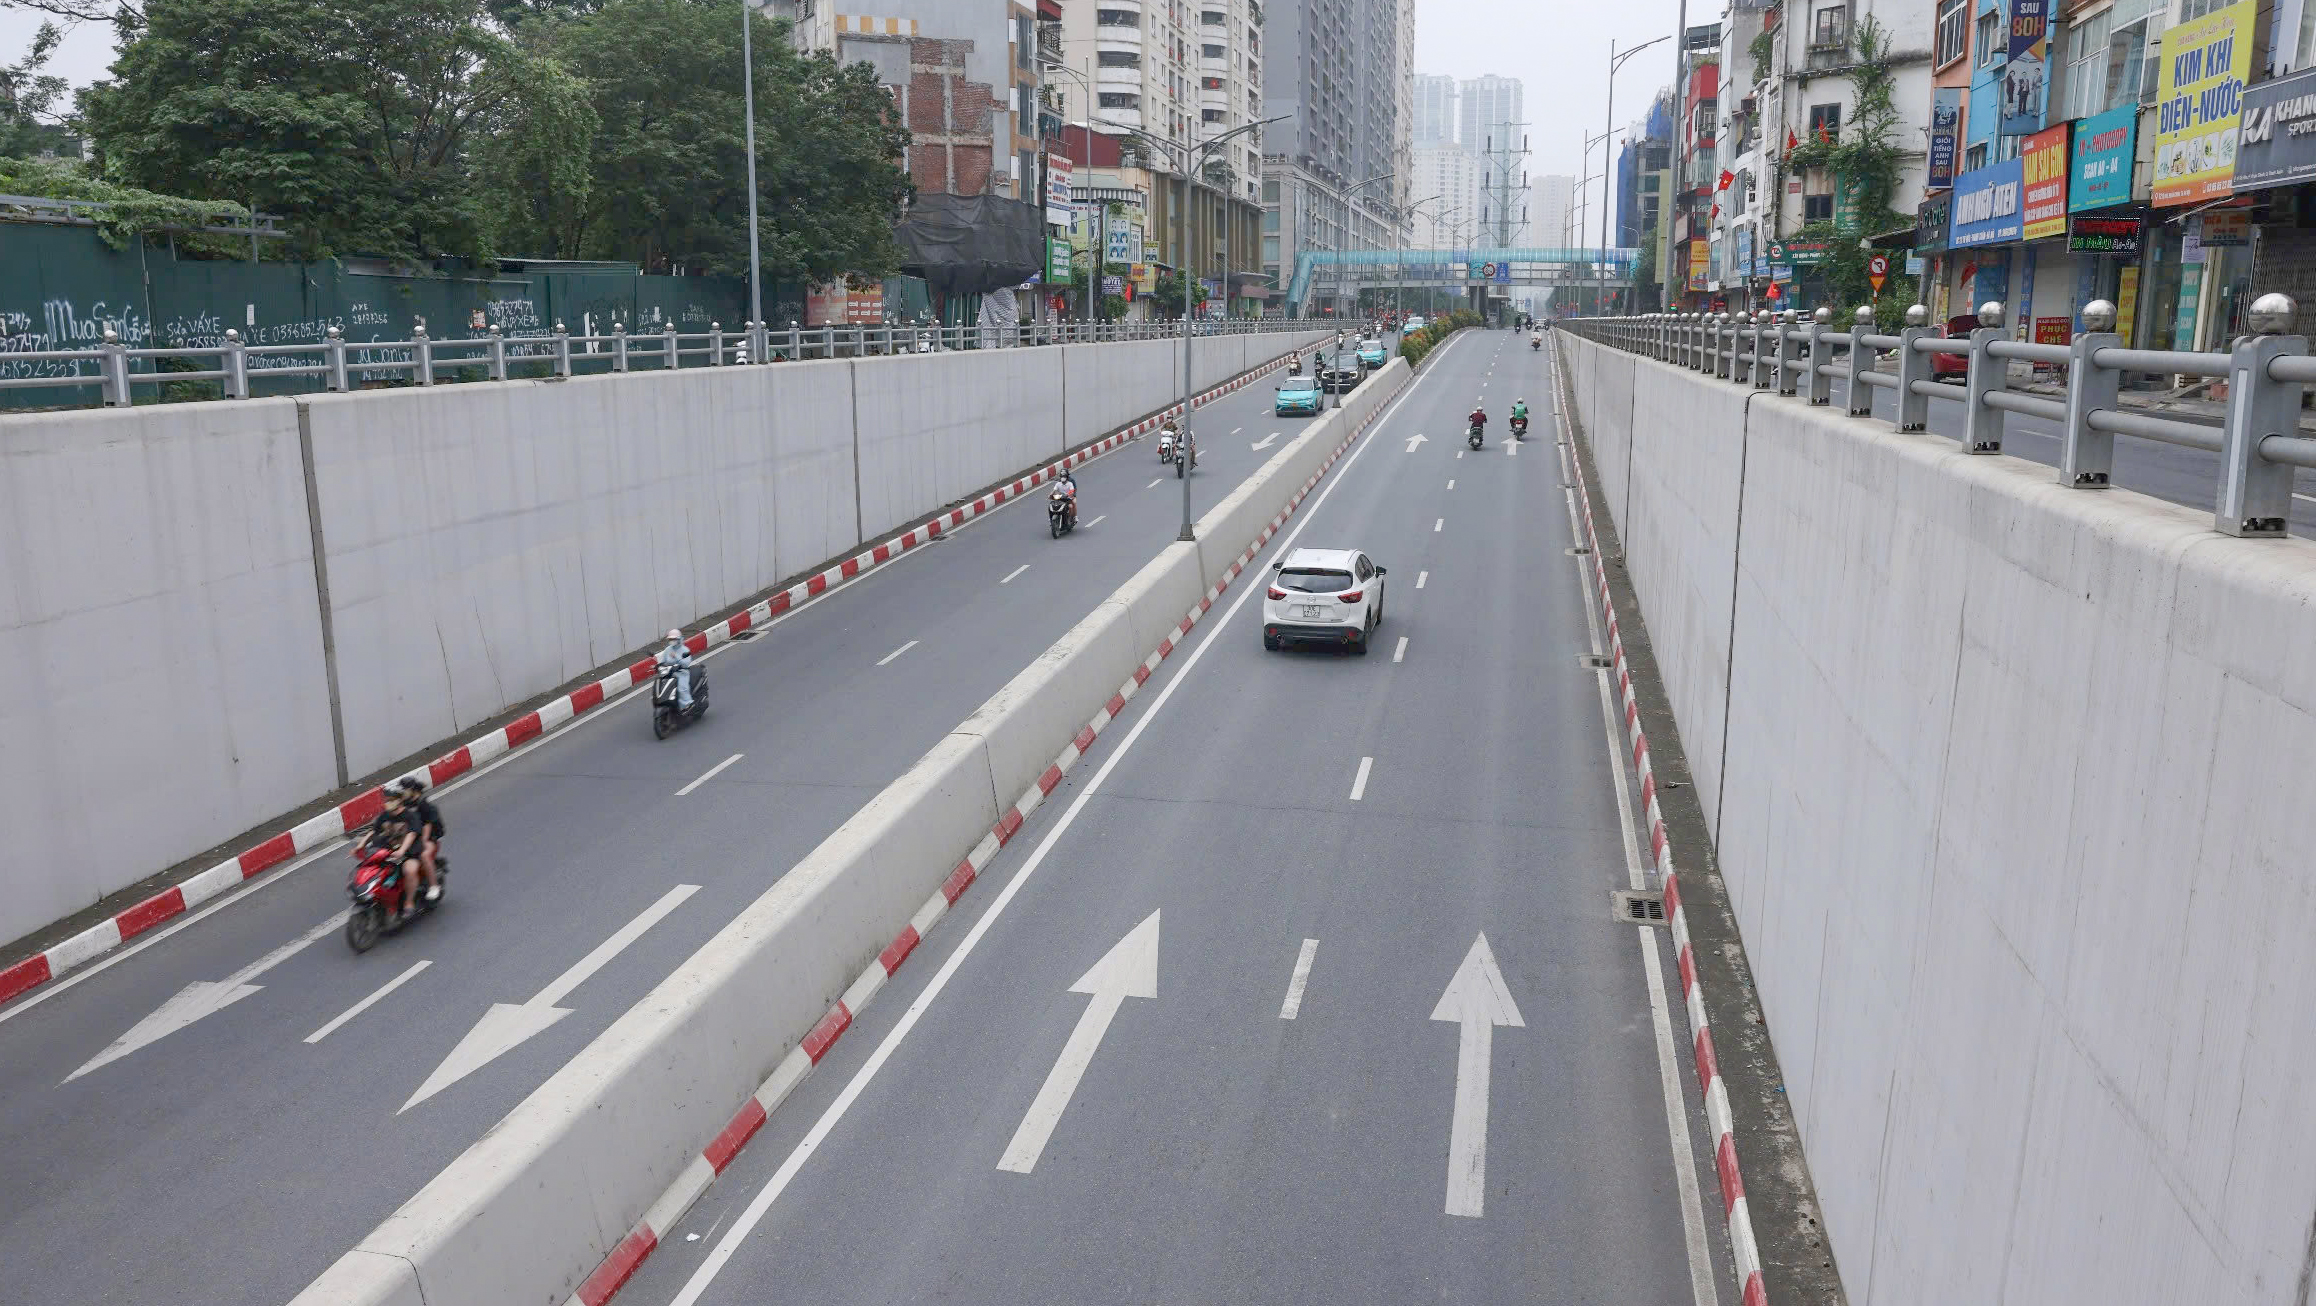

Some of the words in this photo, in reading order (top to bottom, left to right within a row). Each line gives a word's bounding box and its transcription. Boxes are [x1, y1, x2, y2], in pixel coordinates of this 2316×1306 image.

[2013, 15, 2046, 37] 80H
[2020, 2, 2040, 14] SAU
[2173, 48, 2203, 89] KIM
[2205, 28, 2235, 79] KHÍ
[2240, 105, 2273, 146] KA
[44, 299, 96, 342] Mua
